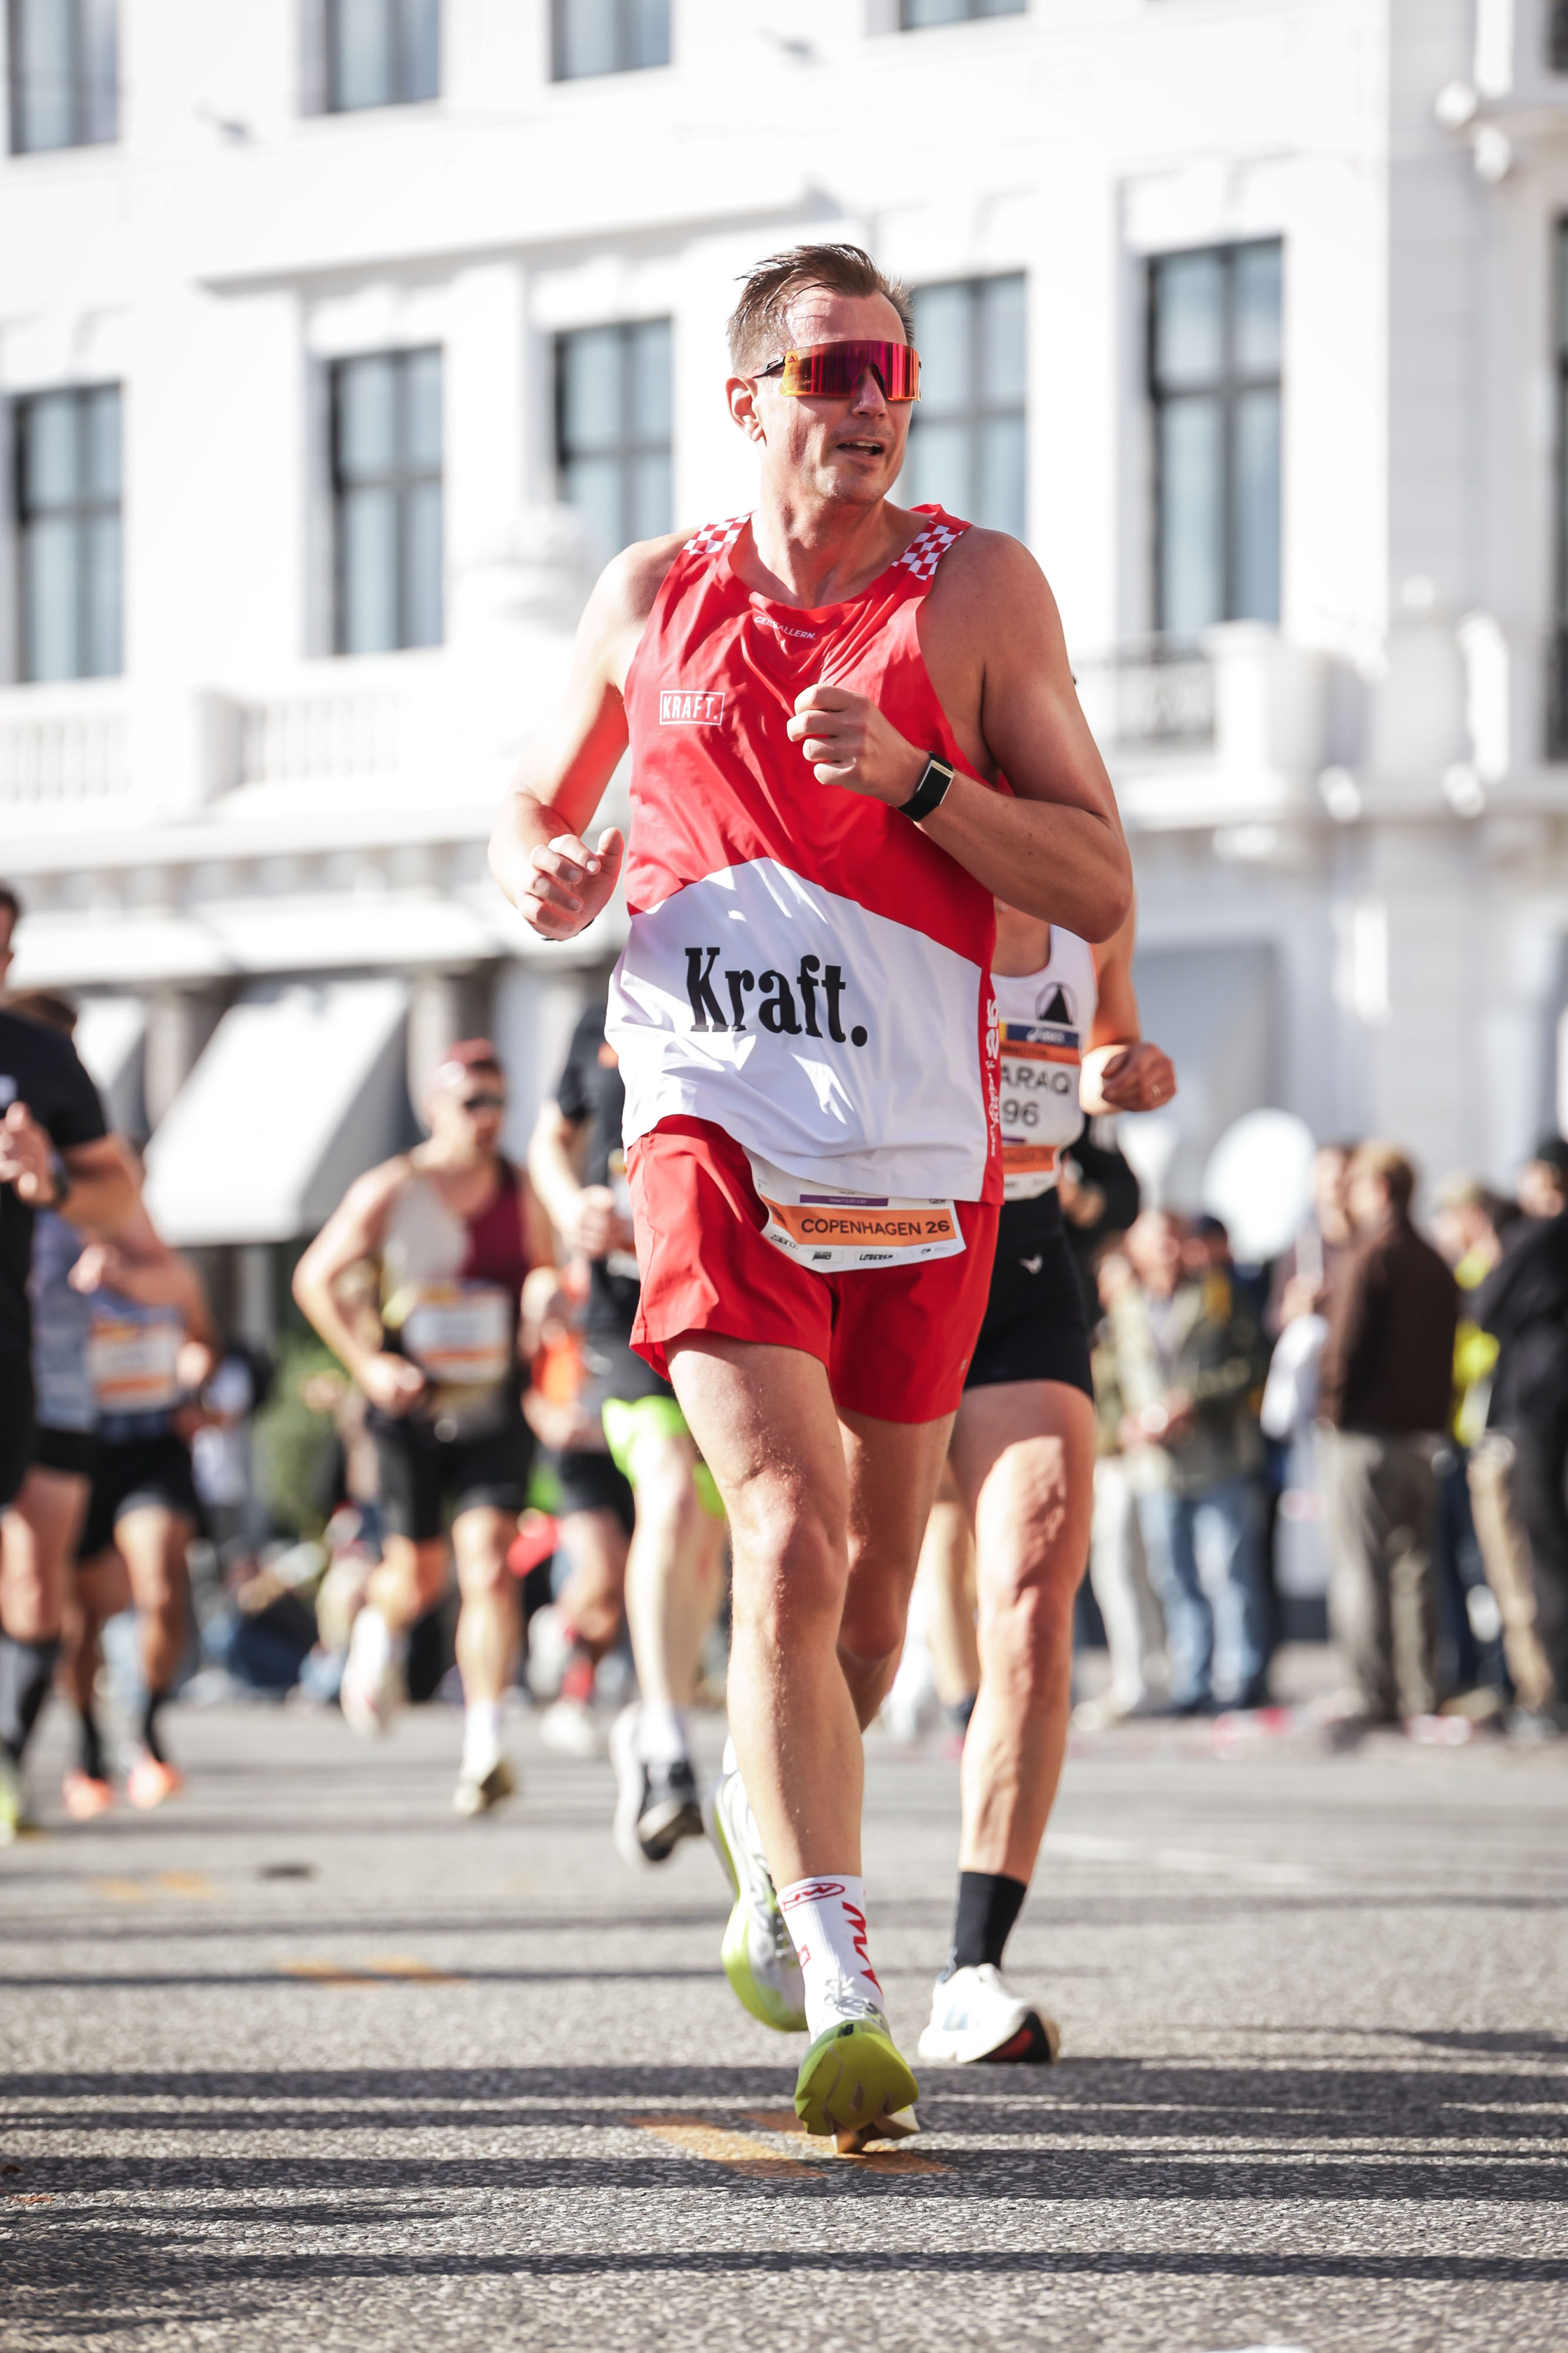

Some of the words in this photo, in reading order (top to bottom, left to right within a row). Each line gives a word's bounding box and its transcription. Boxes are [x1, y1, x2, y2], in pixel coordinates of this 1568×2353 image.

[663, 696, 718, 719] KRAFT.
[685, 947, 868, 1046] Kraft.
[801, 1218, 922, 1235] COPENHAGEN
[925, 1220, 950, 1234] 26
